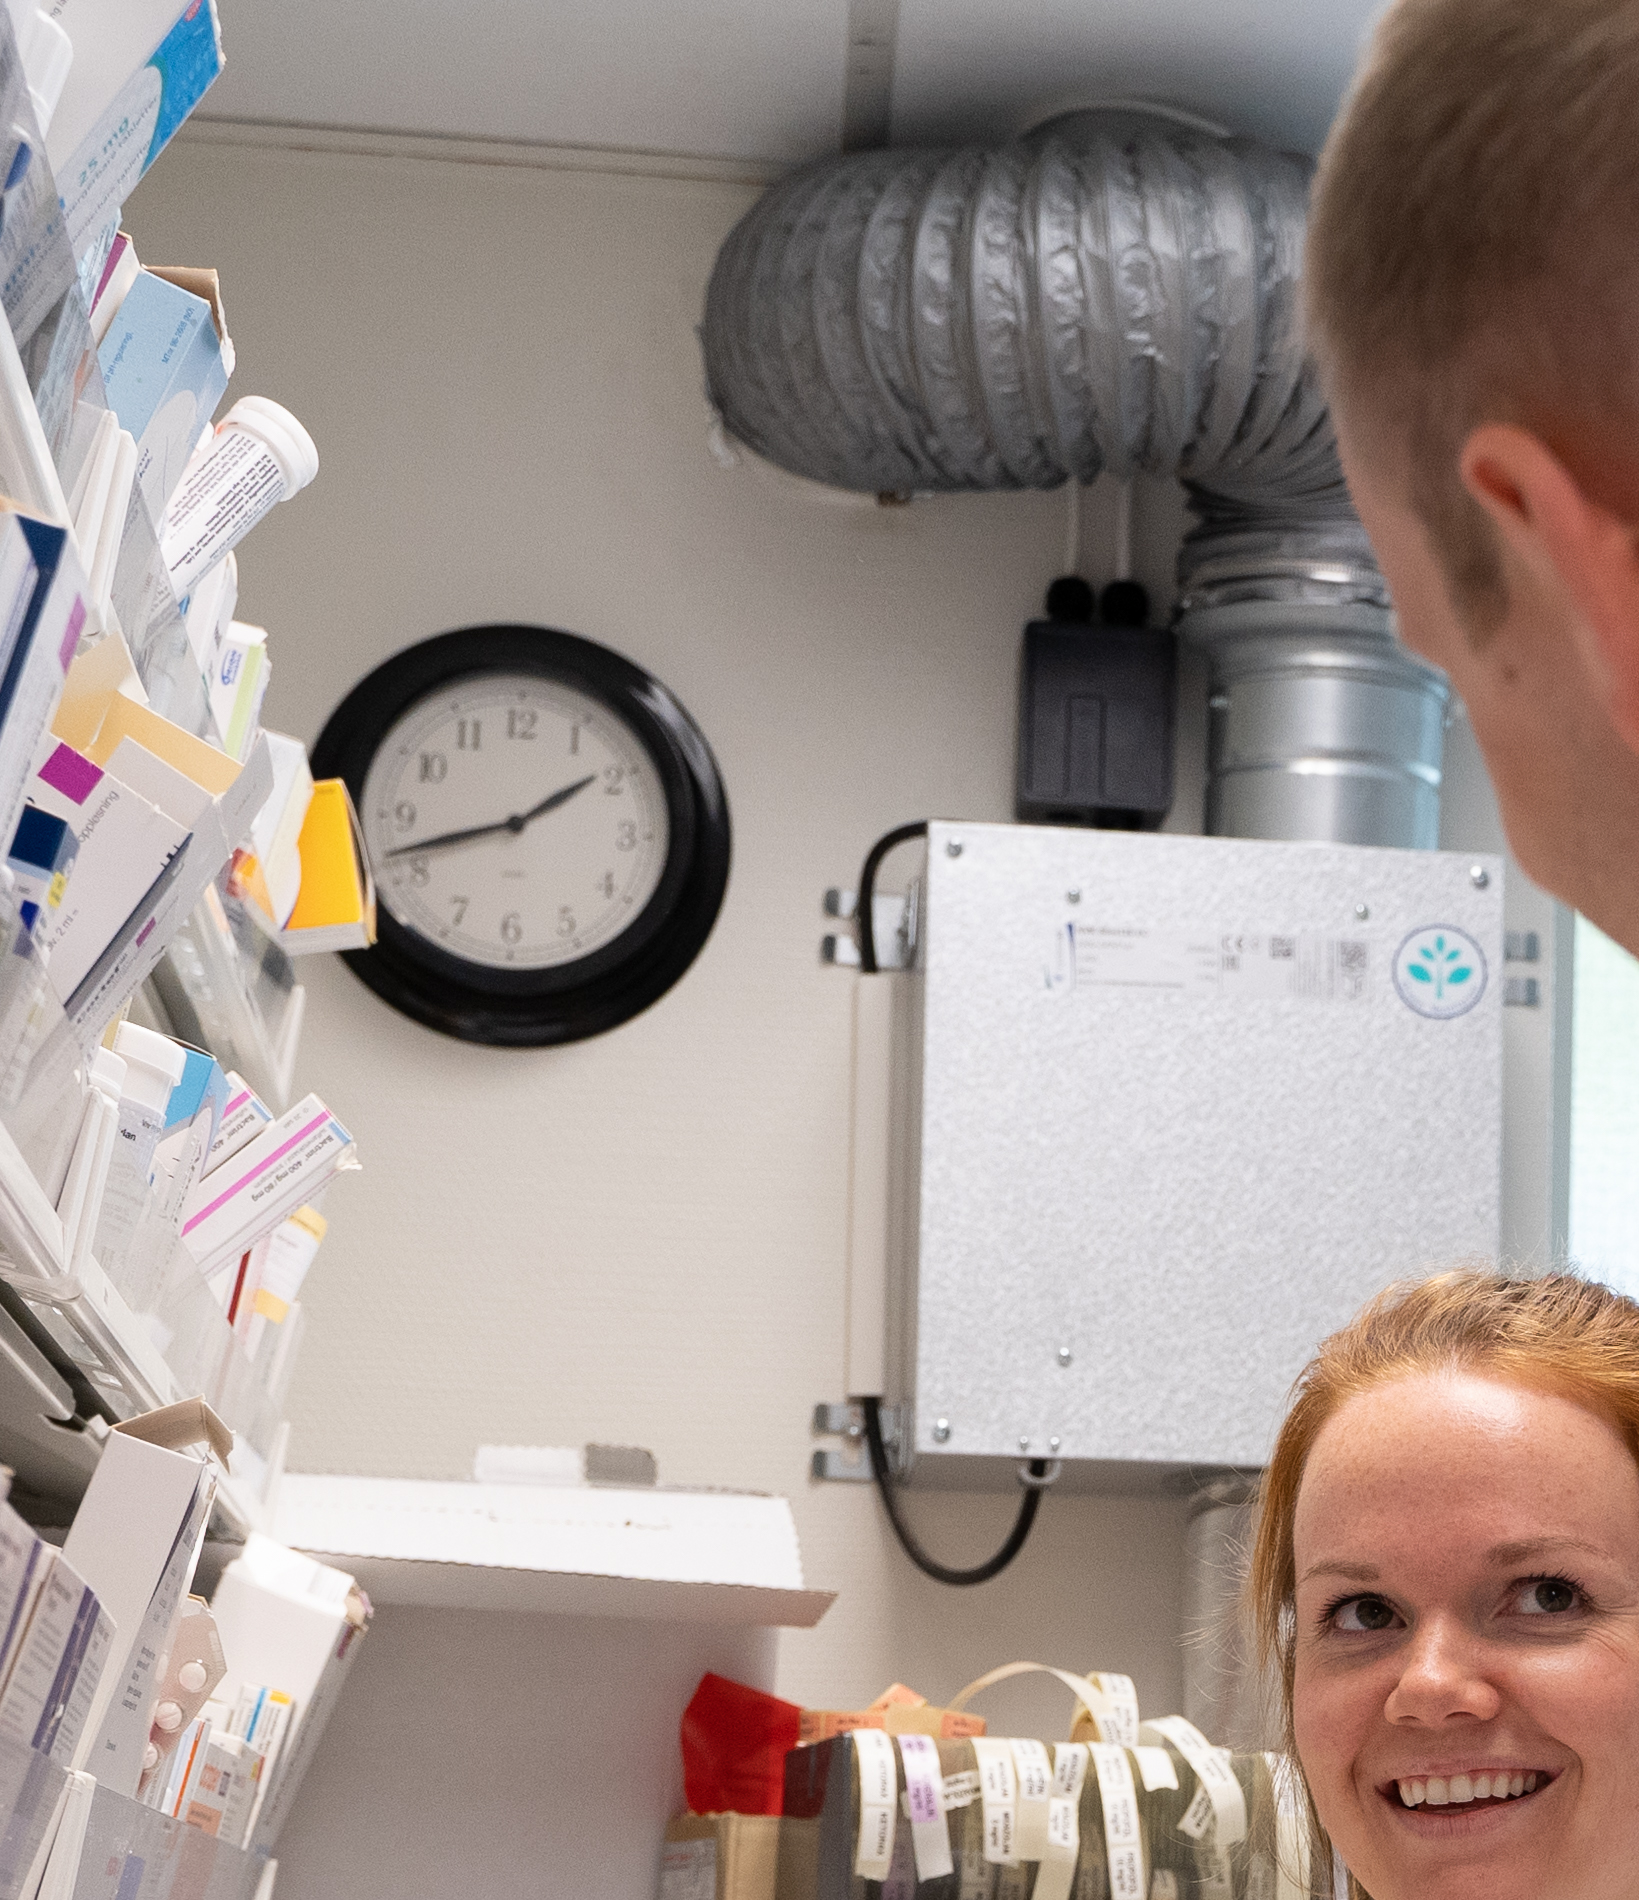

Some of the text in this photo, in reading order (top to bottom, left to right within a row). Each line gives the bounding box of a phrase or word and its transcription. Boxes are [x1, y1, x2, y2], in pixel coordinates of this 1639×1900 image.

[457, 720, 483, 751] 11
[505, 707, 538, 740] 12
[569, 724, 582, 754] 1
[419, 752, 448, 783] 10
[604, 766, 625, 796] 2
[74, 788, 121, 845] oppløsning
[395, 803, 416, 832] 9
[616, 822, 638, 851] 3
[408, 856, 431, 887] 8
[595, 871, 617, 900] 4
[452, 897, 471, 926] 7
[556, 907, 577, 937] 5
[500, 912, 523, 945] 6
[274, 1168, 290, 1183] mg
[286, 1158, 303, 1174] 400
[249, 1188, 265, 1203] mg
[262, 1181, 274, 1193] 80
